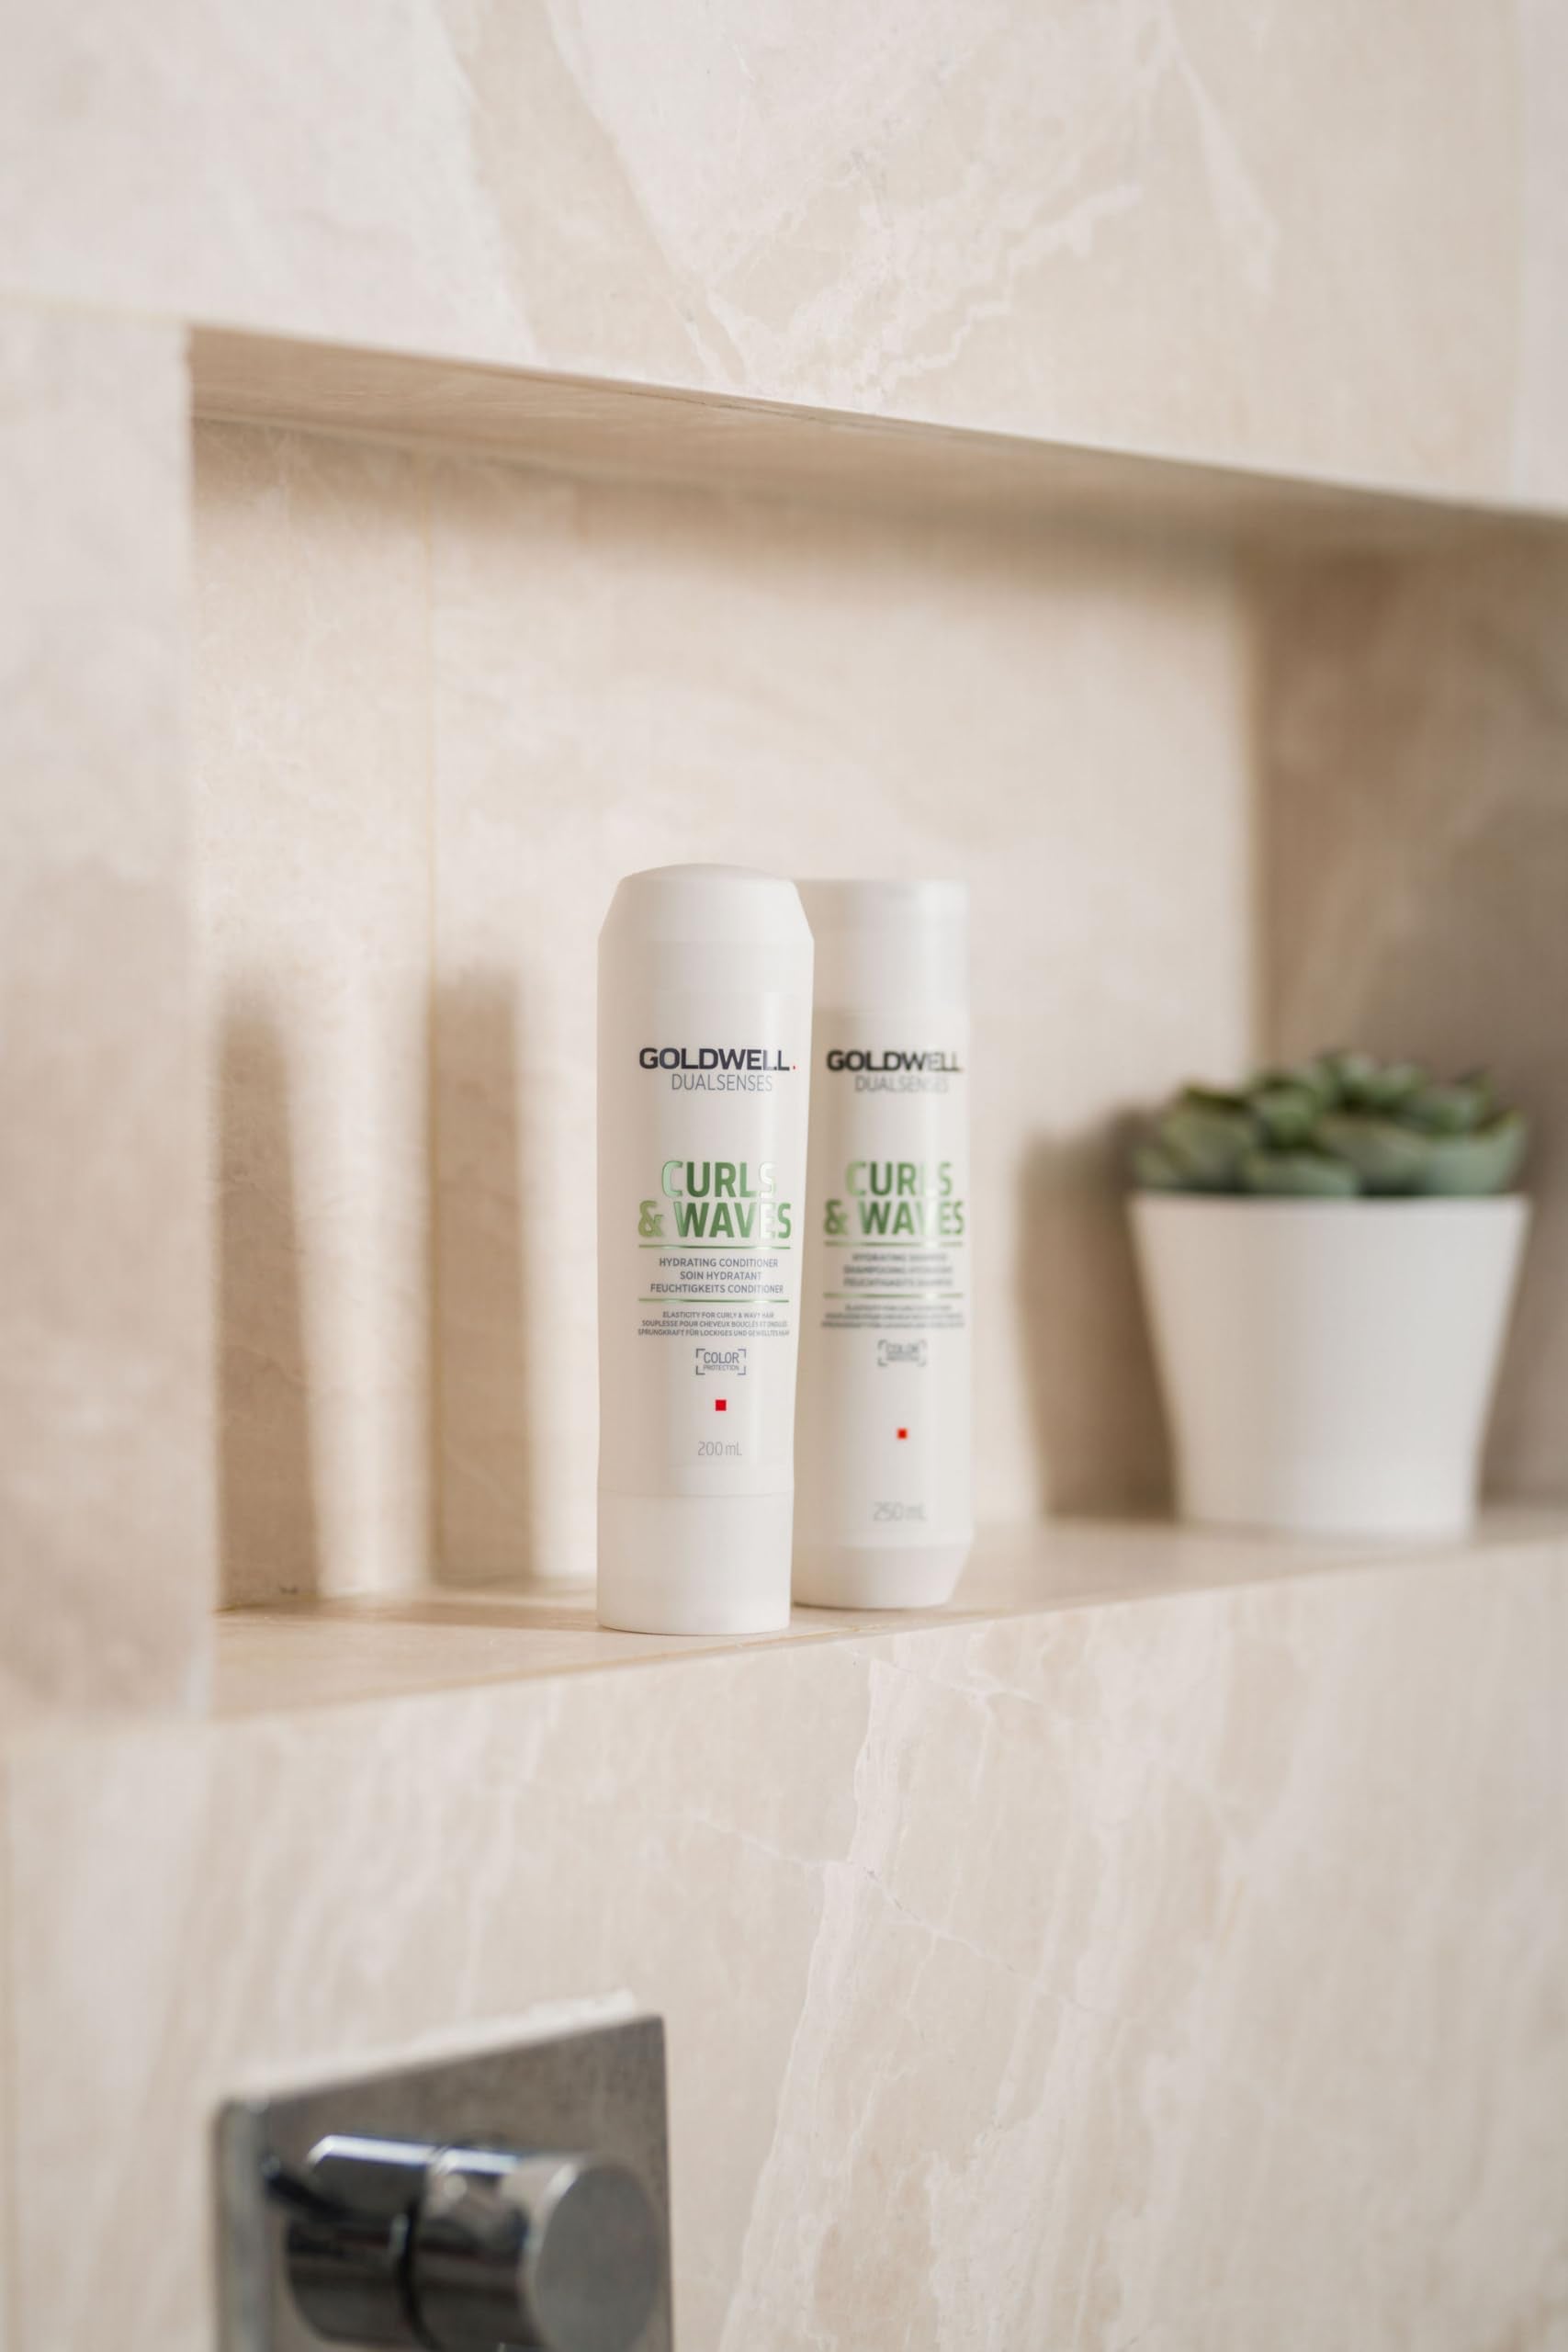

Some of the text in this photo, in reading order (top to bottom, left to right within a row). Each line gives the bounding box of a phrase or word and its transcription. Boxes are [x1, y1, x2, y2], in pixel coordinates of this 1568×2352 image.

[671, 1073, 773, 1091] DUALSENSES
[661, 1160, 776, 1198] CURLS
[845, 1161, 953, 1196] CURLS
[637, 1200, 792, 1239] & WAVES
[824, 1199, 964, 1236] & WAVES
[660, 1257, 778, 1268] HYDRATING CONDITIONER
[680, 1271, 761, 1281] SOIN HYDRATANT
[650, 1283, 784, 1295] FEUCHTIGKEITS CONDITIONER
[704, 1351, 739, 1364] COLOR
[698, 1441, 743, 1456] 200 mL
[873, 1500, 904, 1522] 250
